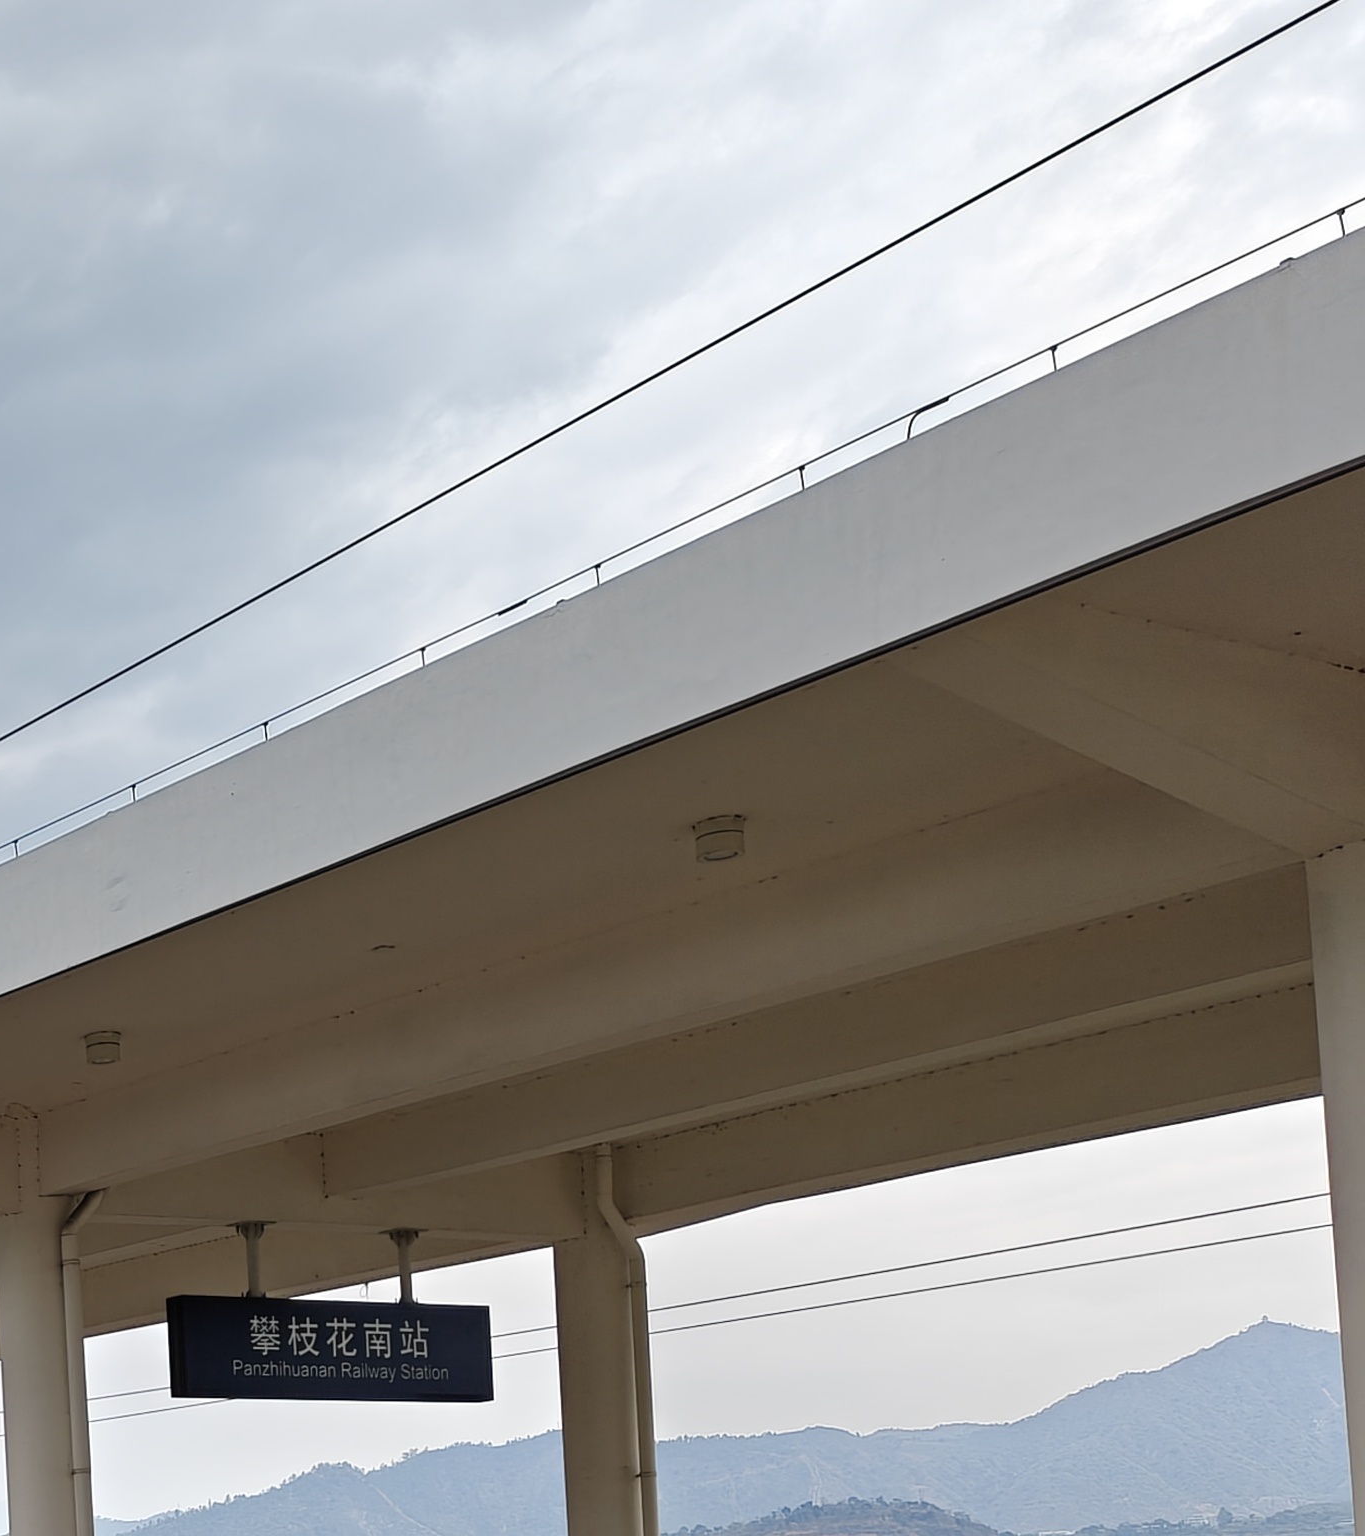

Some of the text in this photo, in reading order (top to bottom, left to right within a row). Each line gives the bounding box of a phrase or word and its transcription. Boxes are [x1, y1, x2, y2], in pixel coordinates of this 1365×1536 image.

[249, 1314, 430, 1360] 攀枝花南站
[232, 1359, 449, 1383] Panzhihuanan Railway Station
